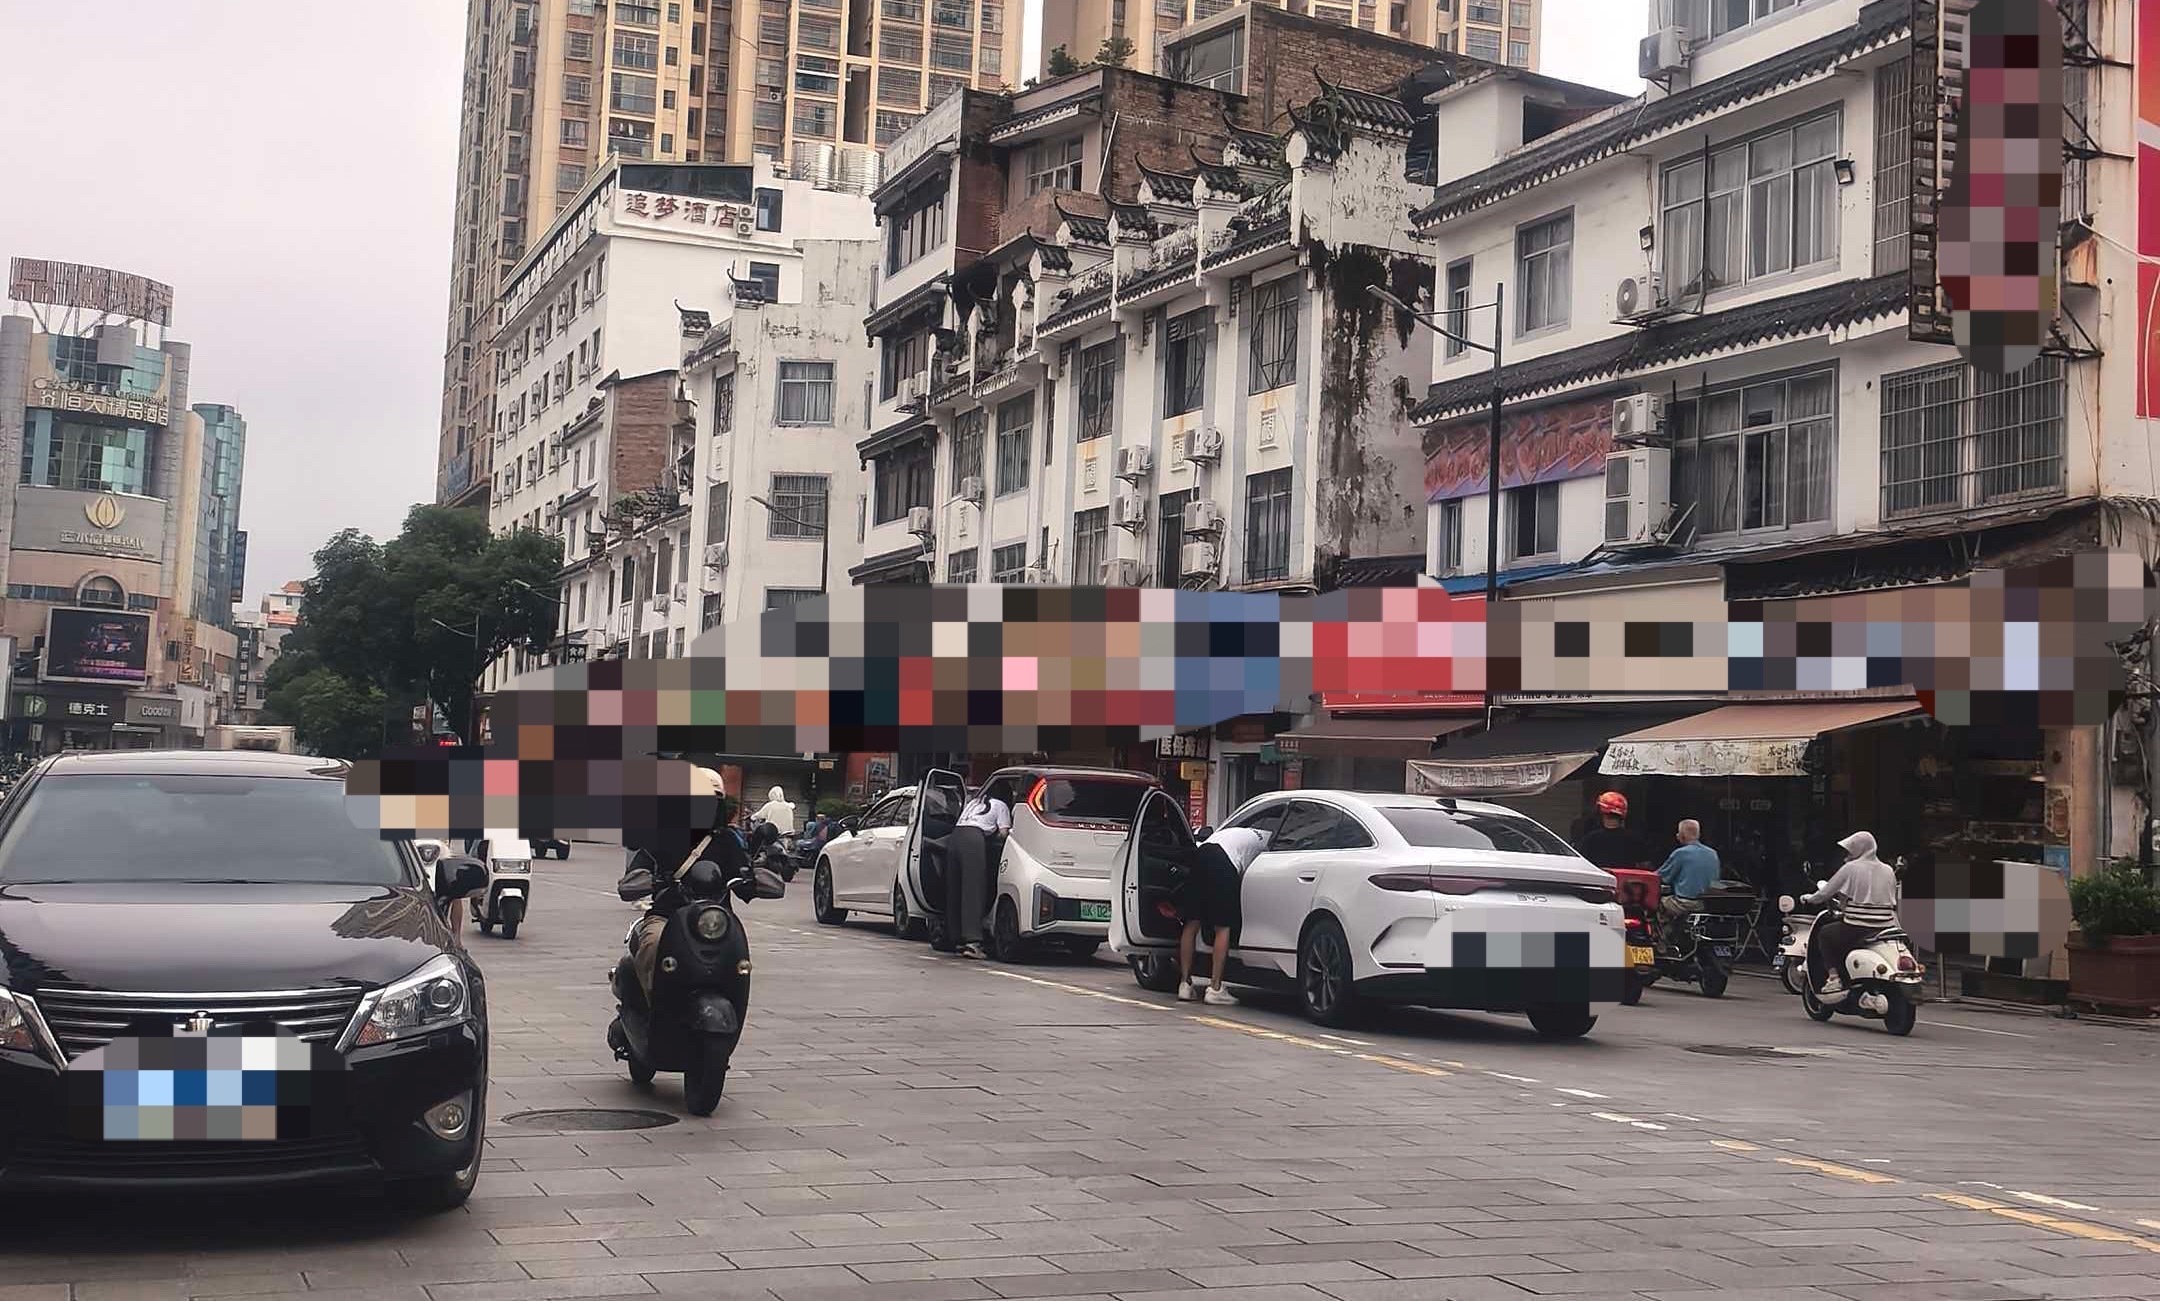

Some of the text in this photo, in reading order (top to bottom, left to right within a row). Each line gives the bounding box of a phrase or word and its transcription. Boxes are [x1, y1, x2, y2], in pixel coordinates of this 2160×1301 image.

[625, 192, 737, 229] 追梦酒店
[69, 702, 109, 716] 德克士
